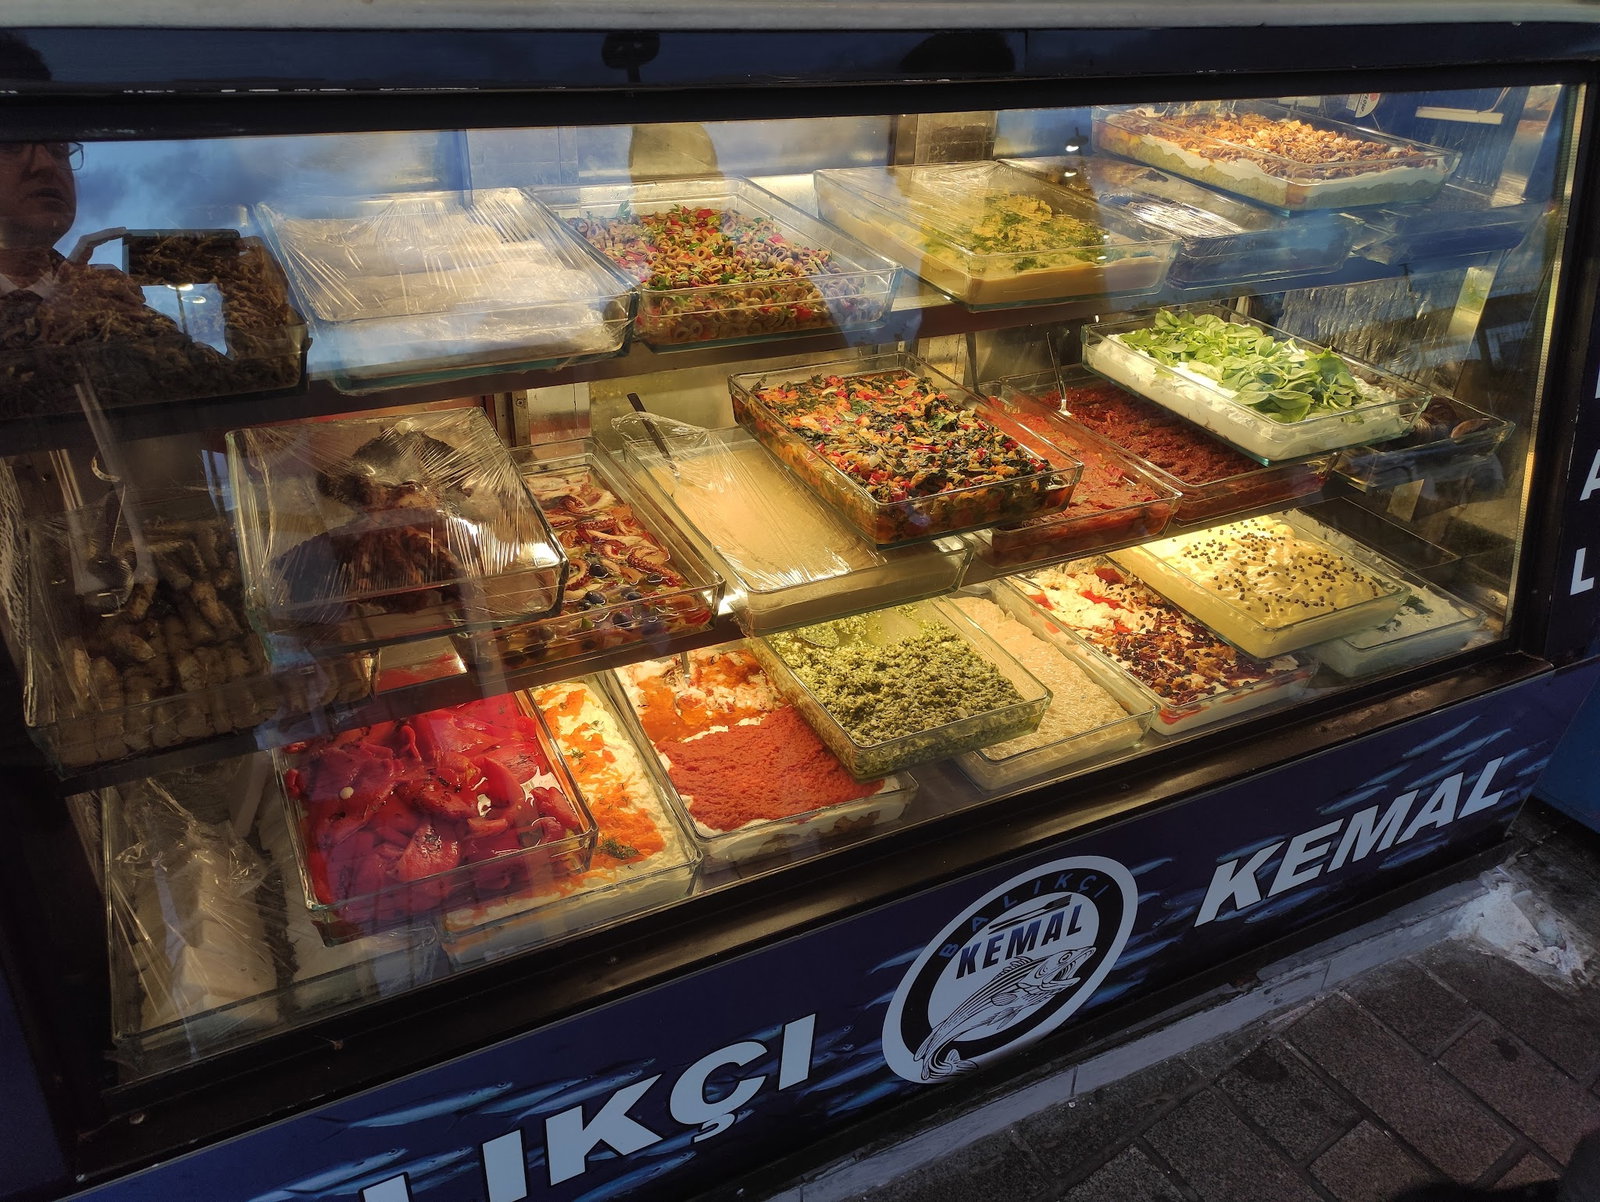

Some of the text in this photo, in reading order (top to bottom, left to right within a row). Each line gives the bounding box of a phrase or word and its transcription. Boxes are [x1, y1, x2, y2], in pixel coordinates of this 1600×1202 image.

[1193, 756, 1505, 928] KEMAL
[938, 872, 1110, 959] BALIKÇI
[955, 903, 1083, 980] KEMAL
